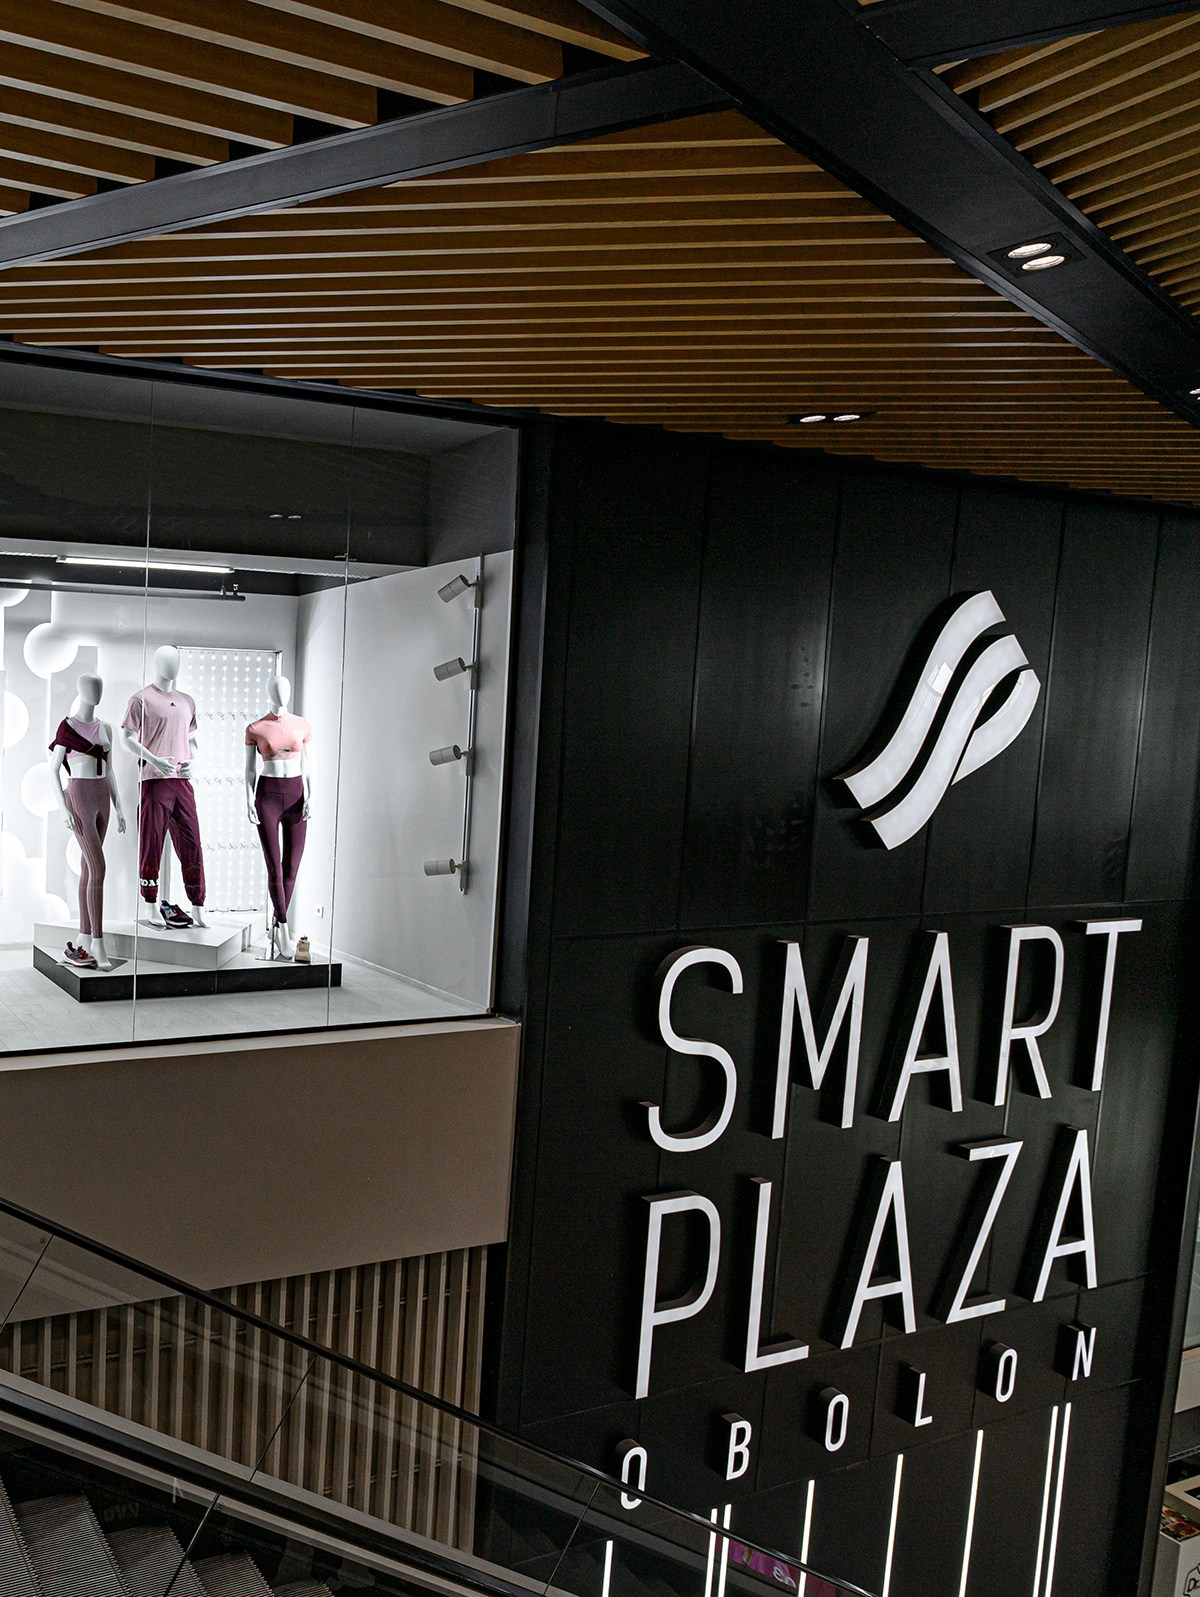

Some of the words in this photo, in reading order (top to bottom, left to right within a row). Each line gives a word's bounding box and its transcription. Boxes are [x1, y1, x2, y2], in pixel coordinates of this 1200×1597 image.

[647, 918, 1143, 1153] SMART
[635, 1128, 1098, 1400] PLAZA
[620, 1327, 1097, 1510] OBOLON
